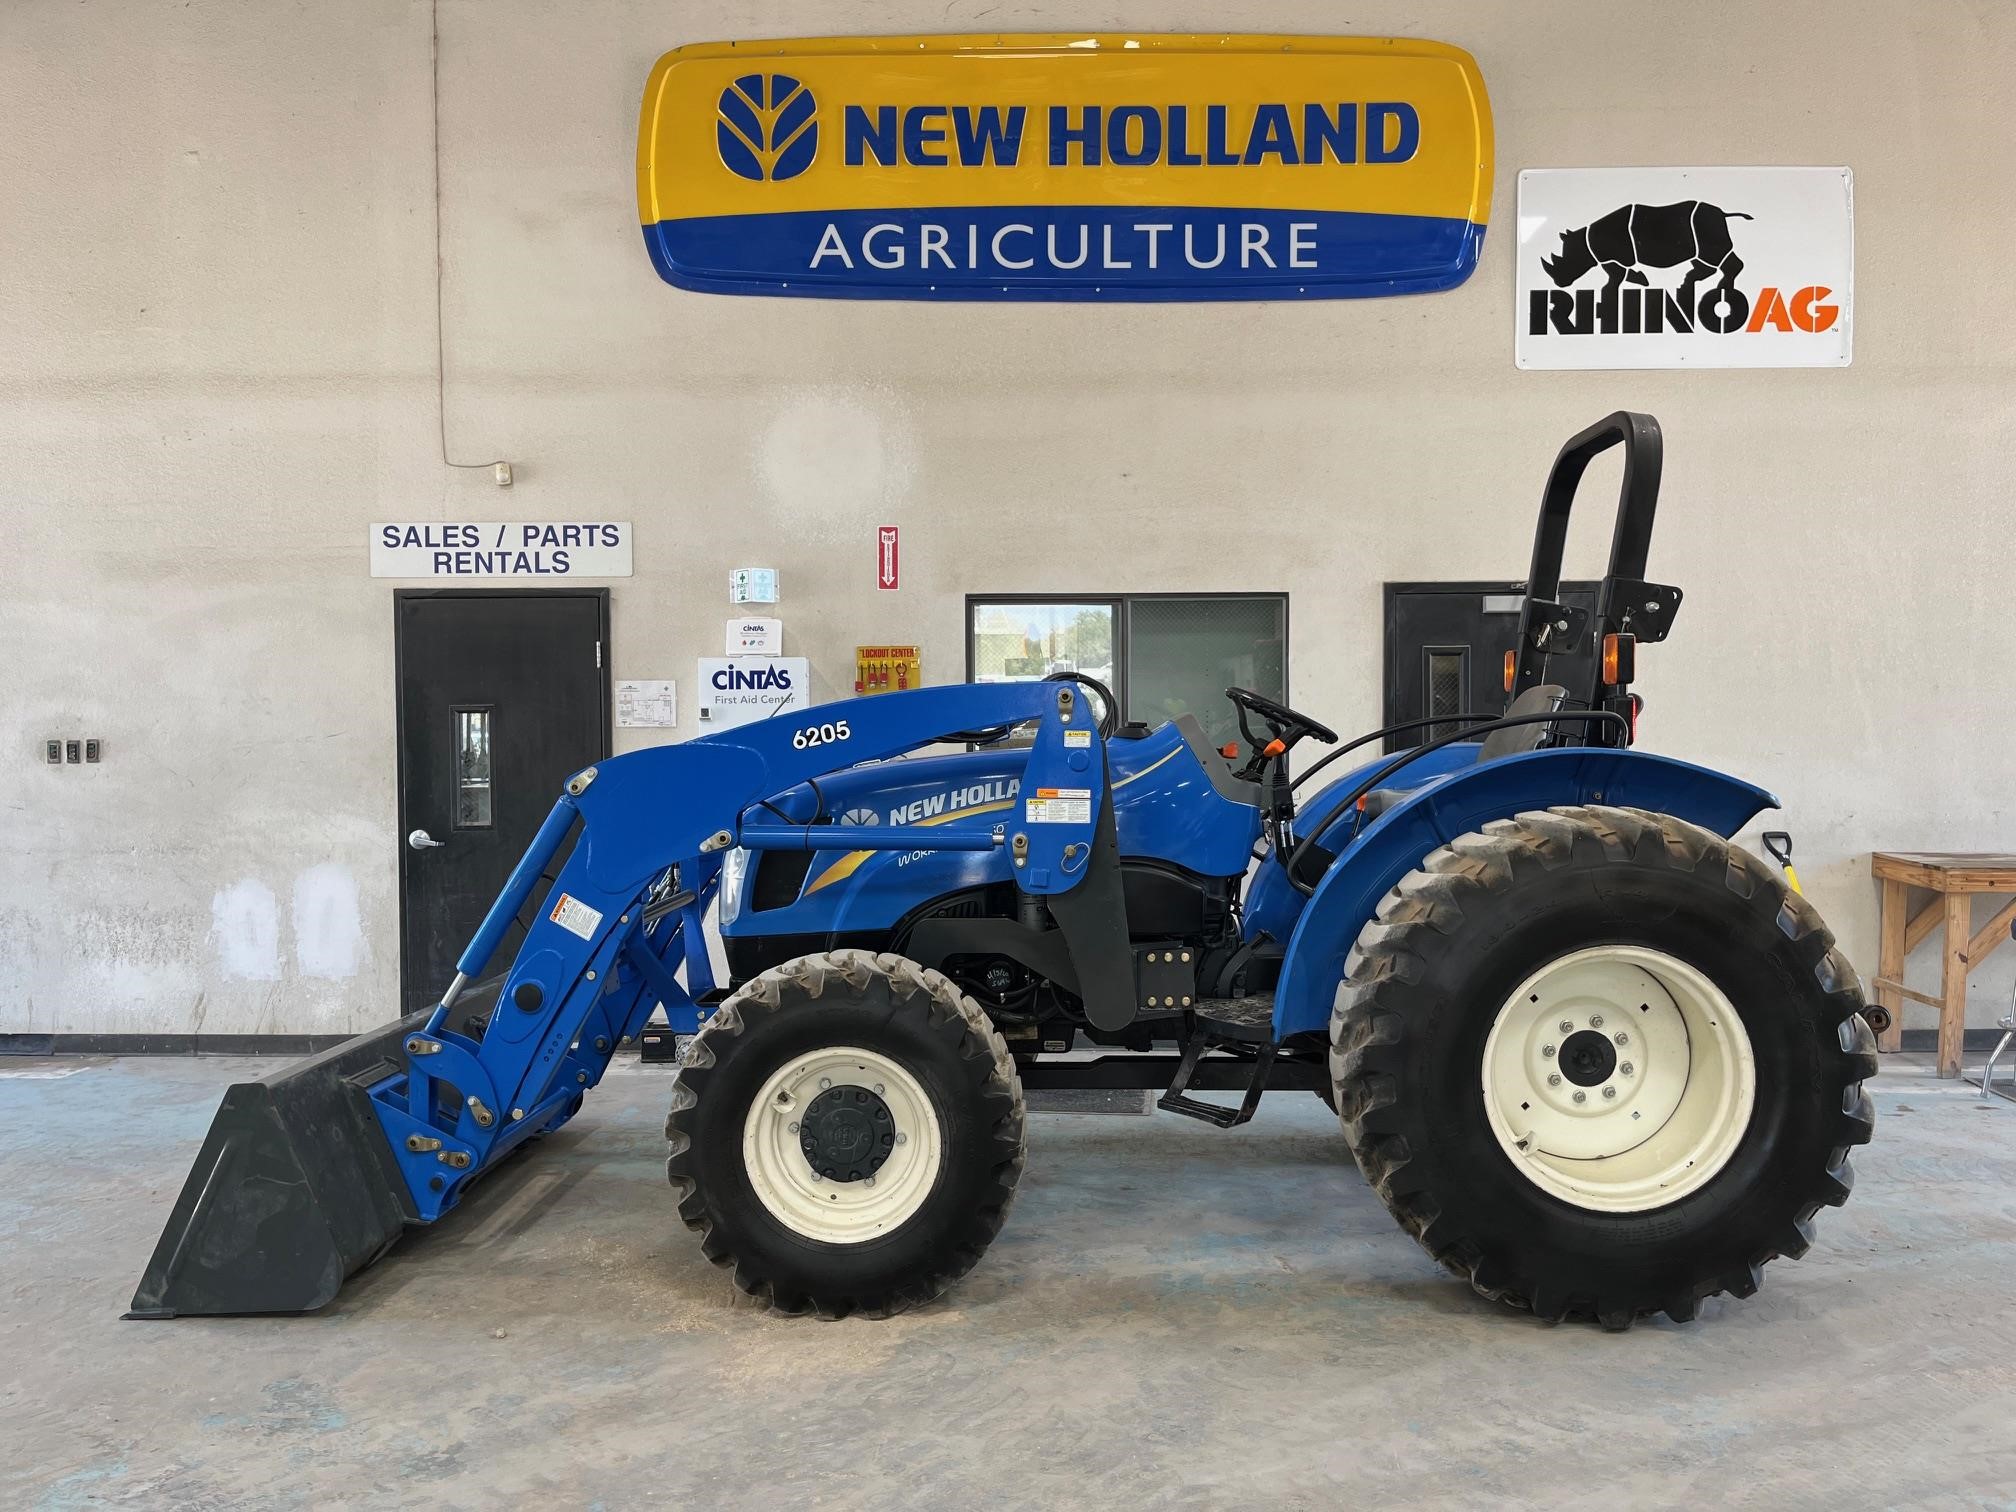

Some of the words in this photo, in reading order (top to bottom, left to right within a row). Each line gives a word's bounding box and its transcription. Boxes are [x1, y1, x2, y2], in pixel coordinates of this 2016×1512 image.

[843, 105, 1027, 167] NEW
[1048, 102, 1421, 166] HOLLAND
[810, 222, 1319, 270] AGRICULTURE
[382, 525, 480, 548] SALES
[496, 525, 506, 548] /
[523, 524, 620, 547] PARTS
[434, 551, 570, 574] RENTALS
[863, 648, 889, 658] LOCKOUT
[891, 648, 914, 658] CENTER
[715, 695, 737, 704] First
[740, 695, 757, 704] Aid
[760, 695, 795, 704] Center
[793, 720, 851, 750] 6205
[889, 794, 946, 827] NEW
[949, 779, 1020, 810] HOLLA
